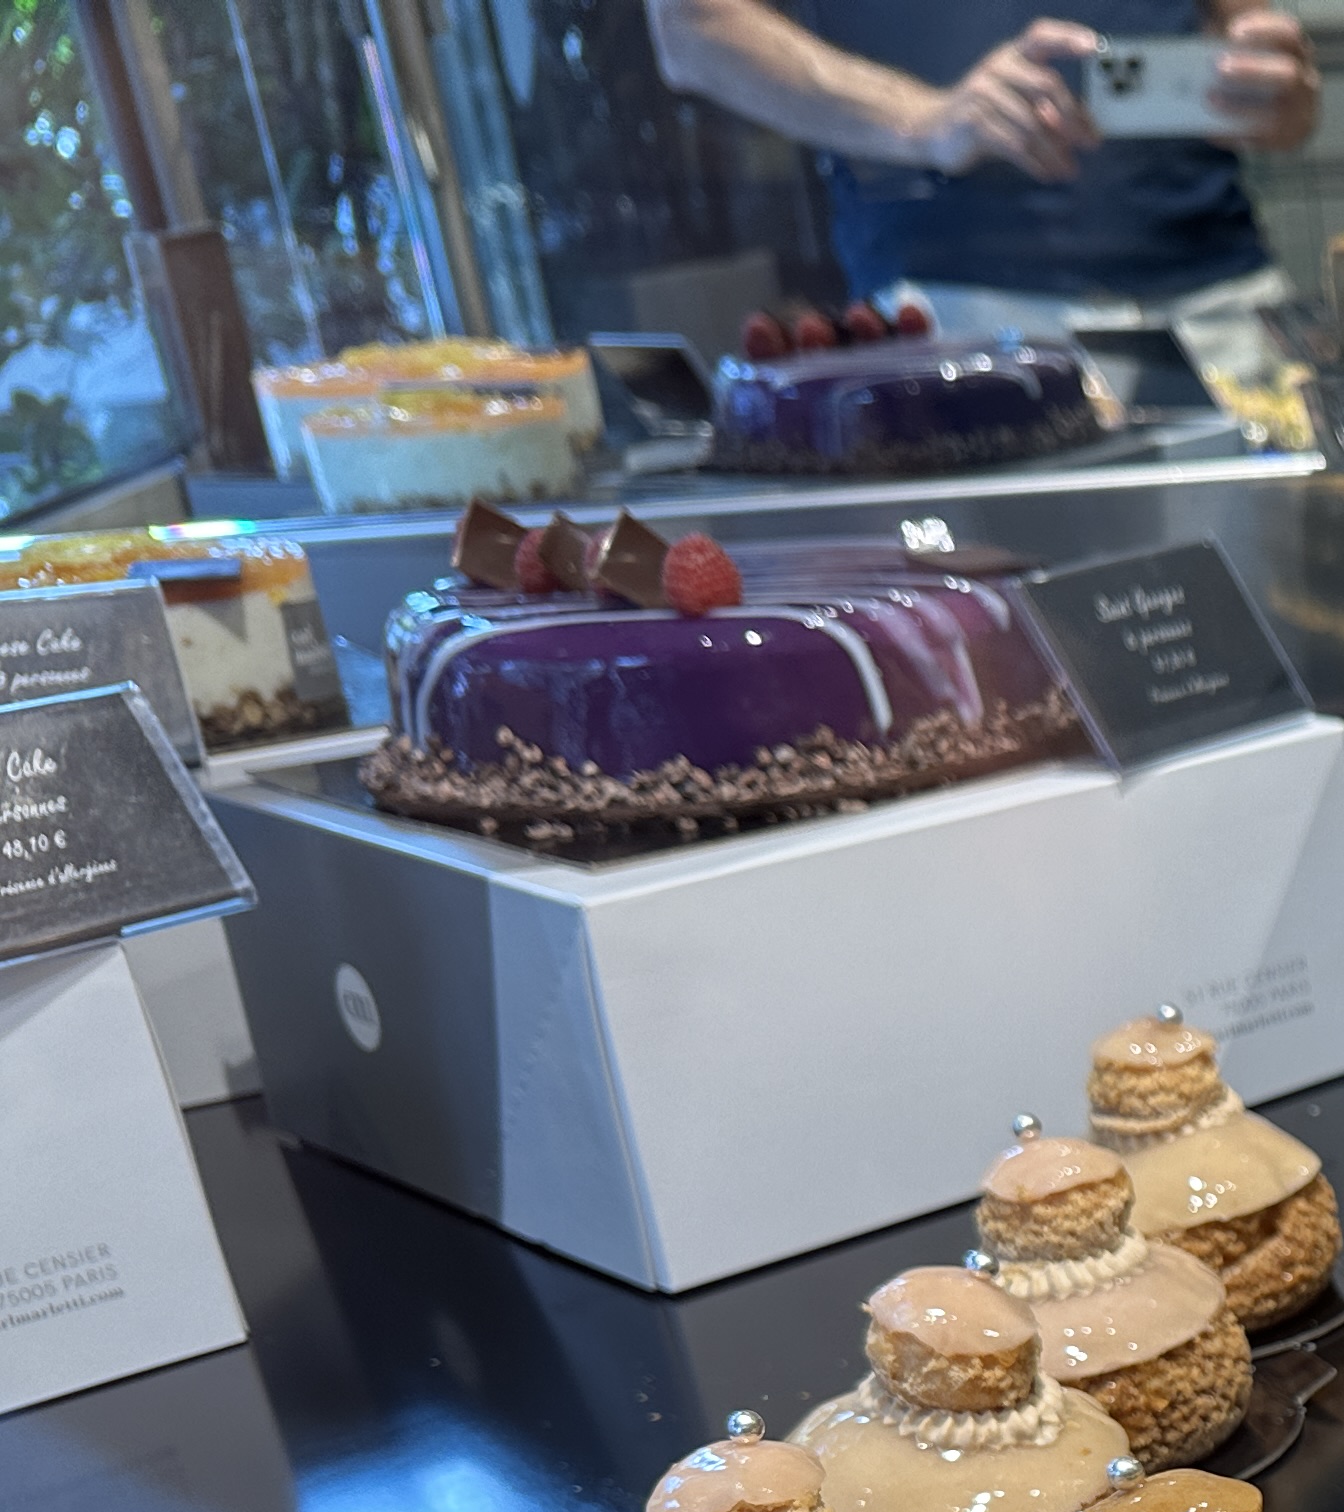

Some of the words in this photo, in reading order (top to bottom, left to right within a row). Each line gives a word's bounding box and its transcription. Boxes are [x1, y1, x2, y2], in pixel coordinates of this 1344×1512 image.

[7, 748, 57, 782] Cake
[0, 795, 67, 825] rsonnes
[24, 1242, 111, 1280] CENSIER
[62, 1263, 118, 1292] PARIS
